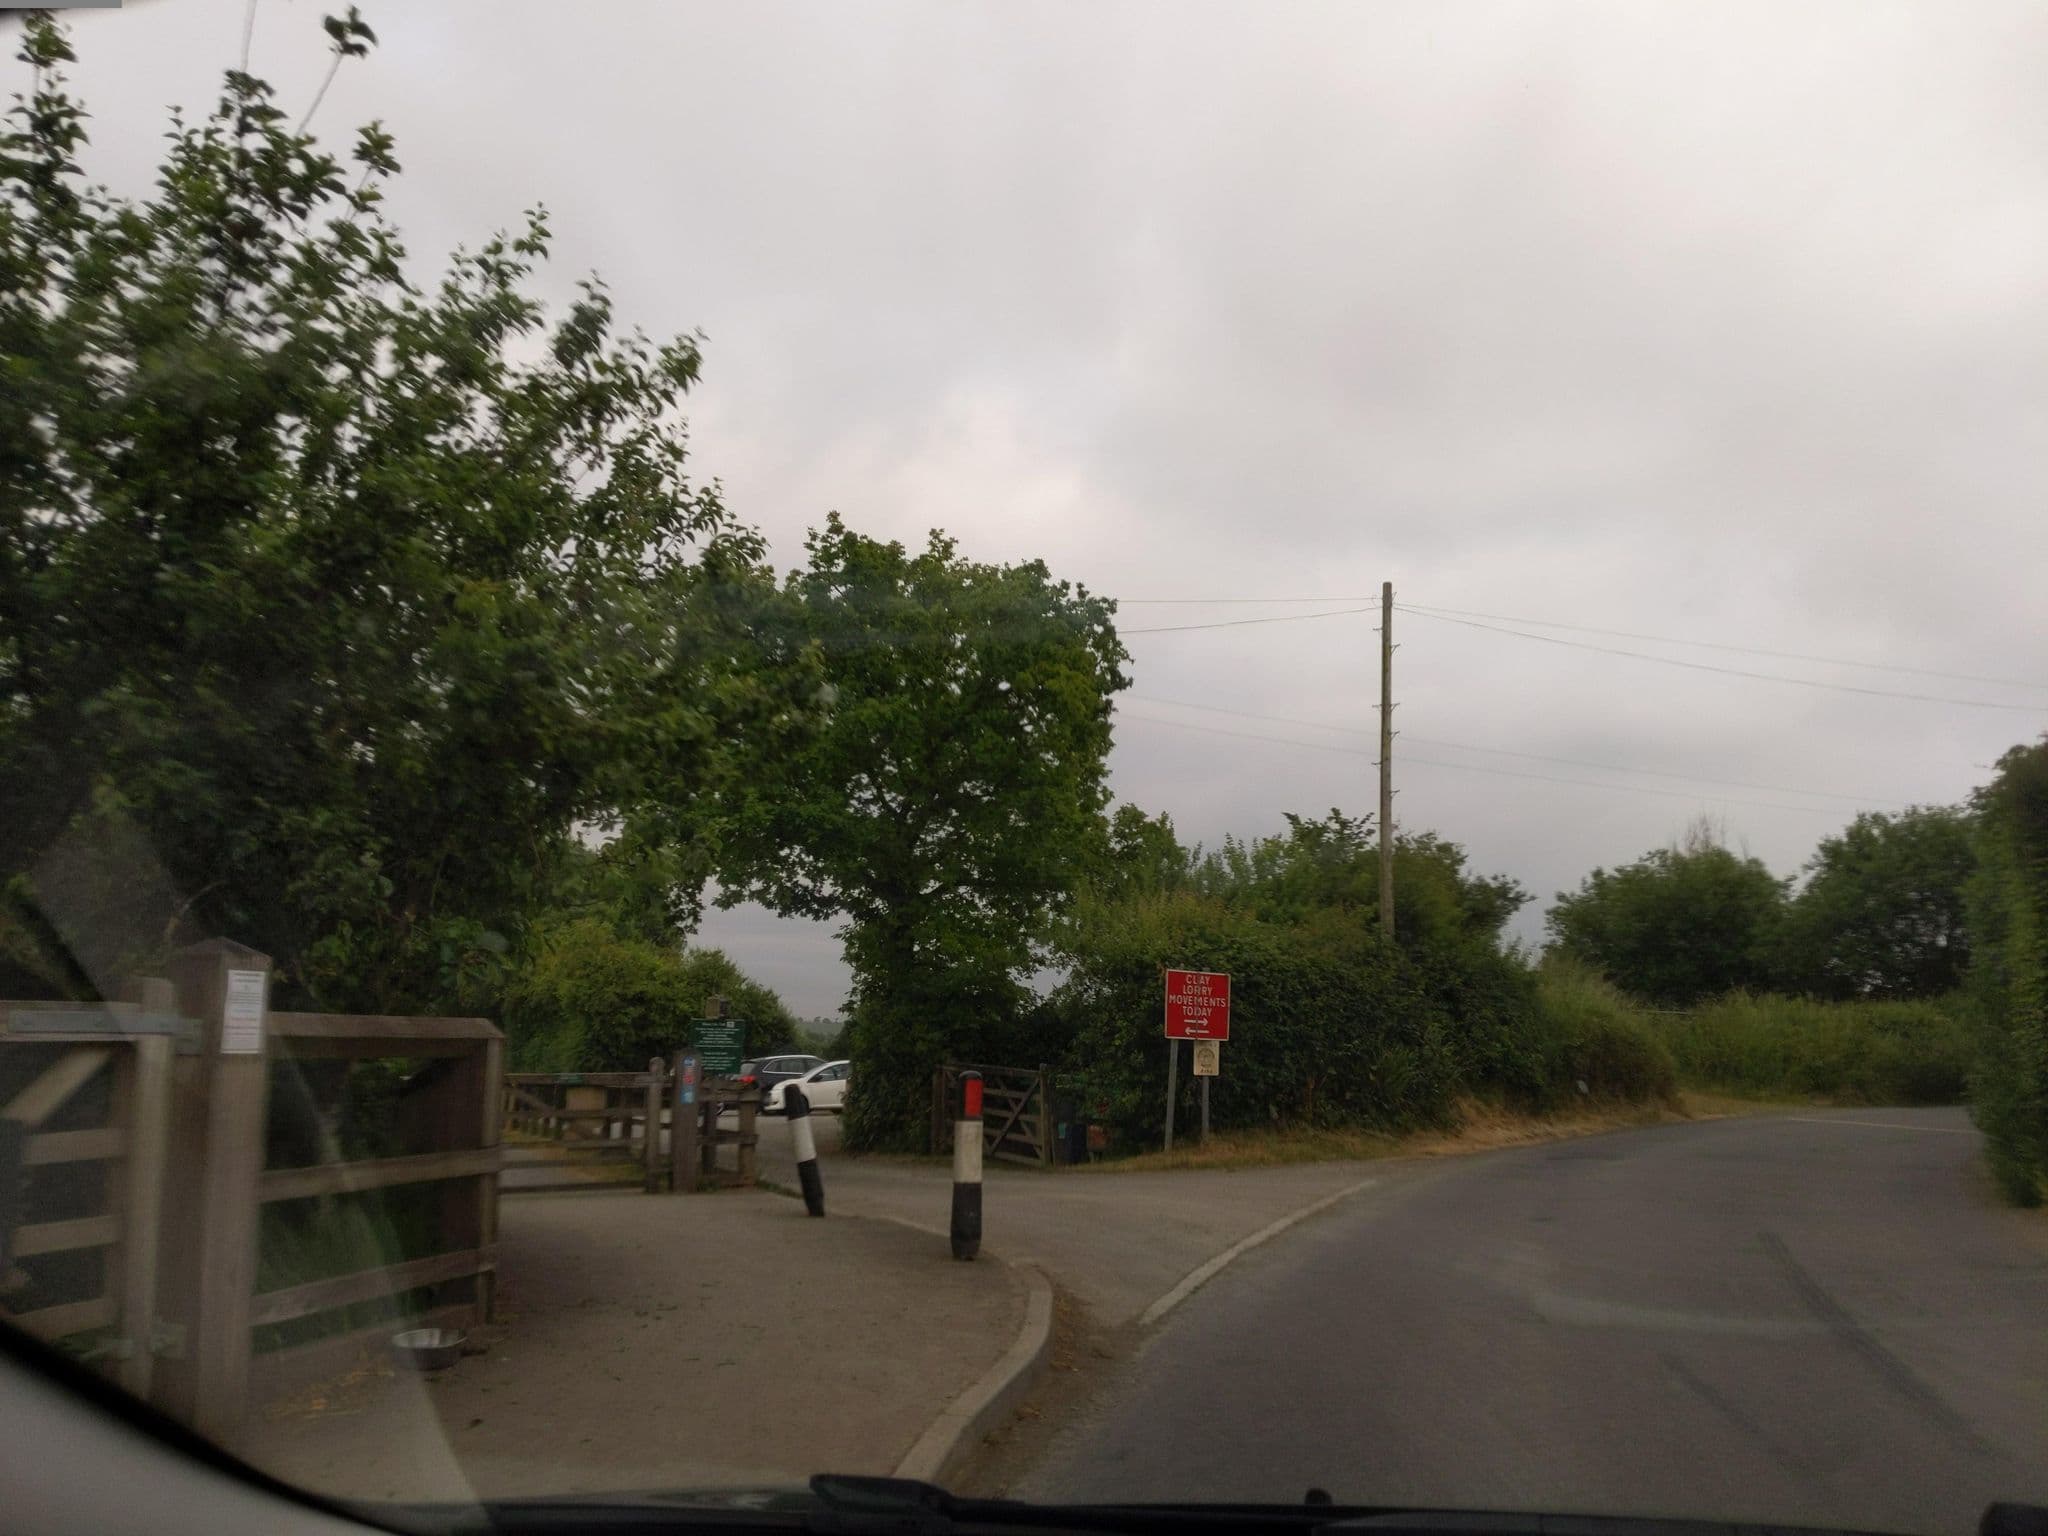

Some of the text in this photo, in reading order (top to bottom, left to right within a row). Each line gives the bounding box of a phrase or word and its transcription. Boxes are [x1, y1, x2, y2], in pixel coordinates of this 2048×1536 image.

[1186, 974, 1210, 984] CLAY
[1183, 985, 1213, 995] LORRY
[1169, 995, 1226, 1007] MOVEMENTS
[1183, 1005, 1212, 1016] TODAY
